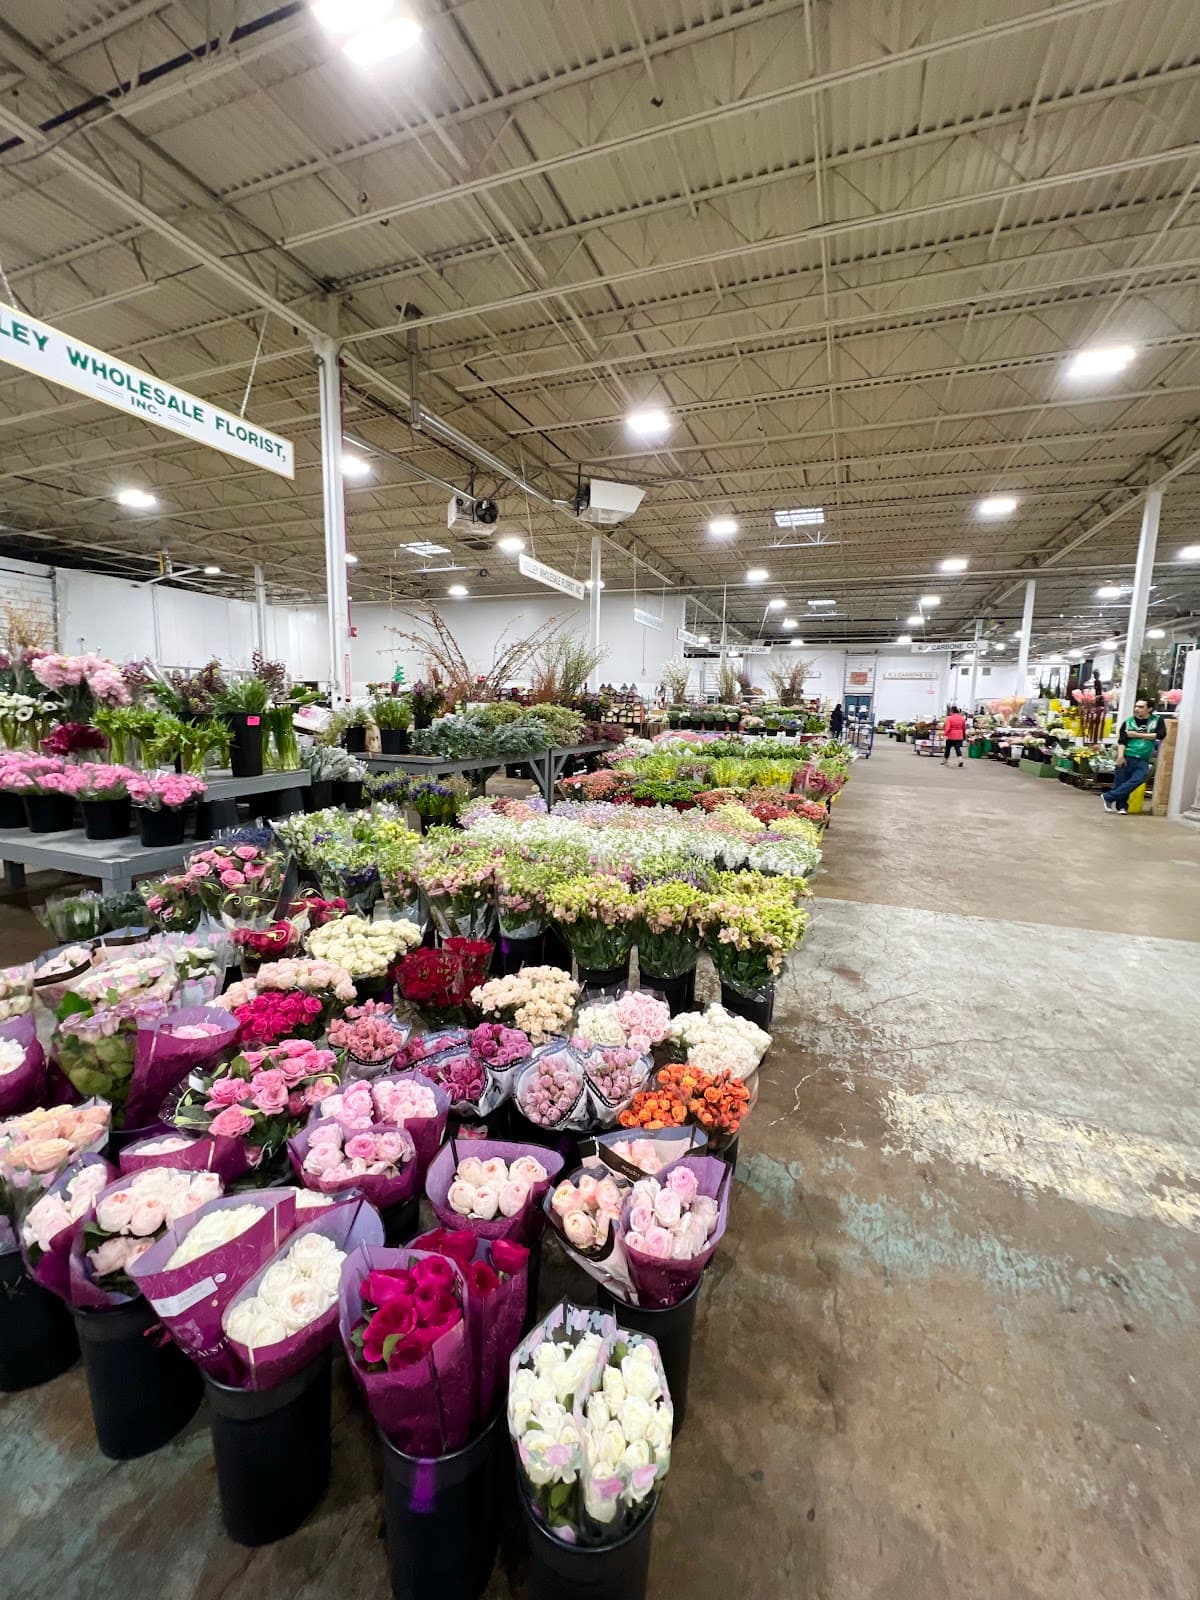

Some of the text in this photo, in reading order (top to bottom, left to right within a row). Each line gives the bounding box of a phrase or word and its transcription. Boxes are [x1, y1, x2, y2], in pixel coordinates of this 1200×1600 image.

[66, 344, 205, 423] WHOLESALE
[215, 415, 286, 463] FLORIST,
[131, 396, 163, 417] INC.
[931, 642, 963, 651] CARBONE
